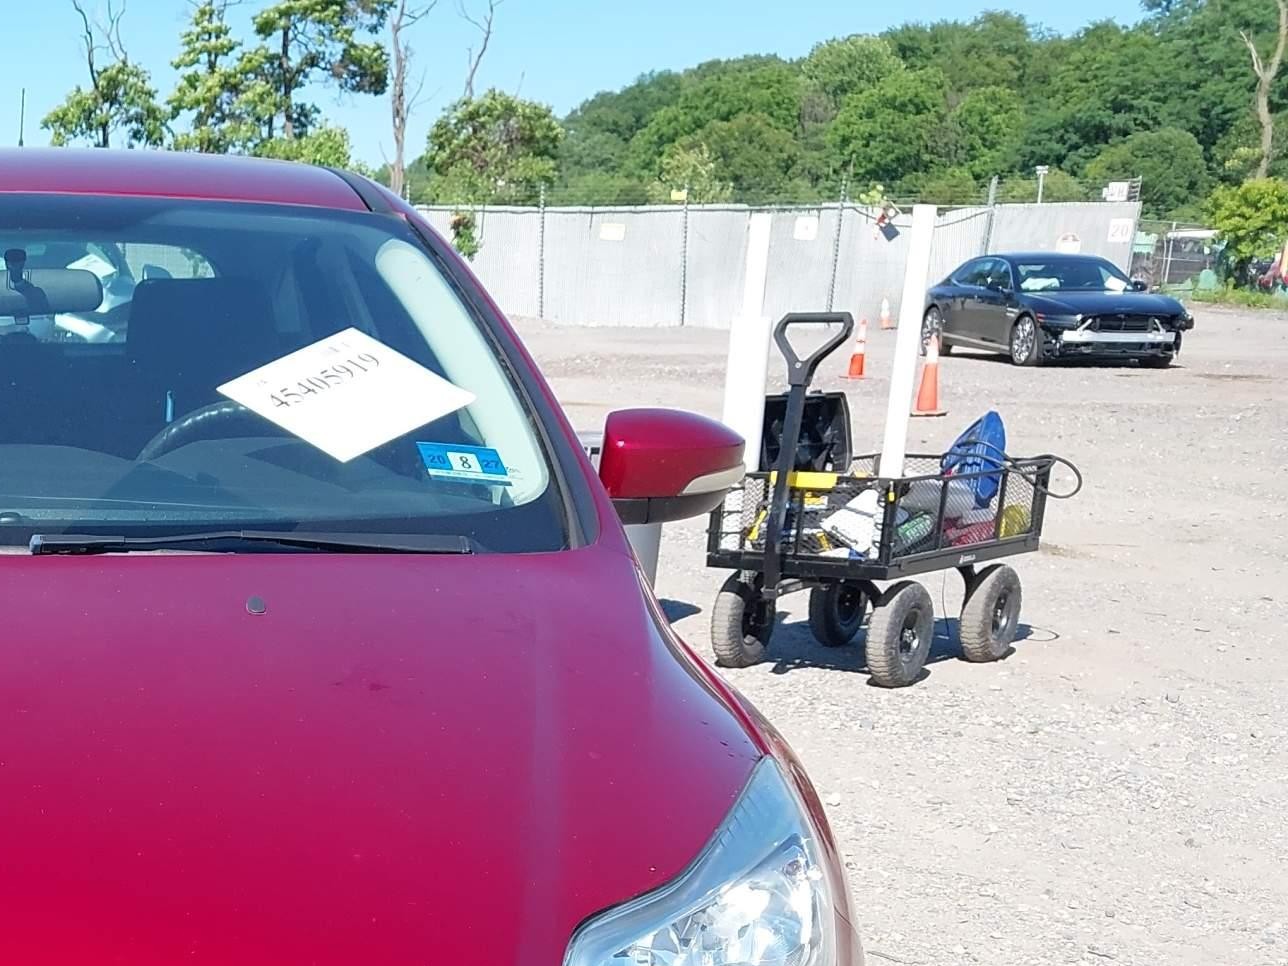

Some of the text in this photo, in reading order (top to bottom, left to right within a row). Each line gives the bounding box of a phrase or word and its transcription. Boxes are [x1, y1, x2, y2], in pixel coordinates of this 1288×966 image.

[1111, 224, 1129, 238] 20
[270, 353, 380, 408] 45405919
[428, 455, 500, 470] 20 8 27
